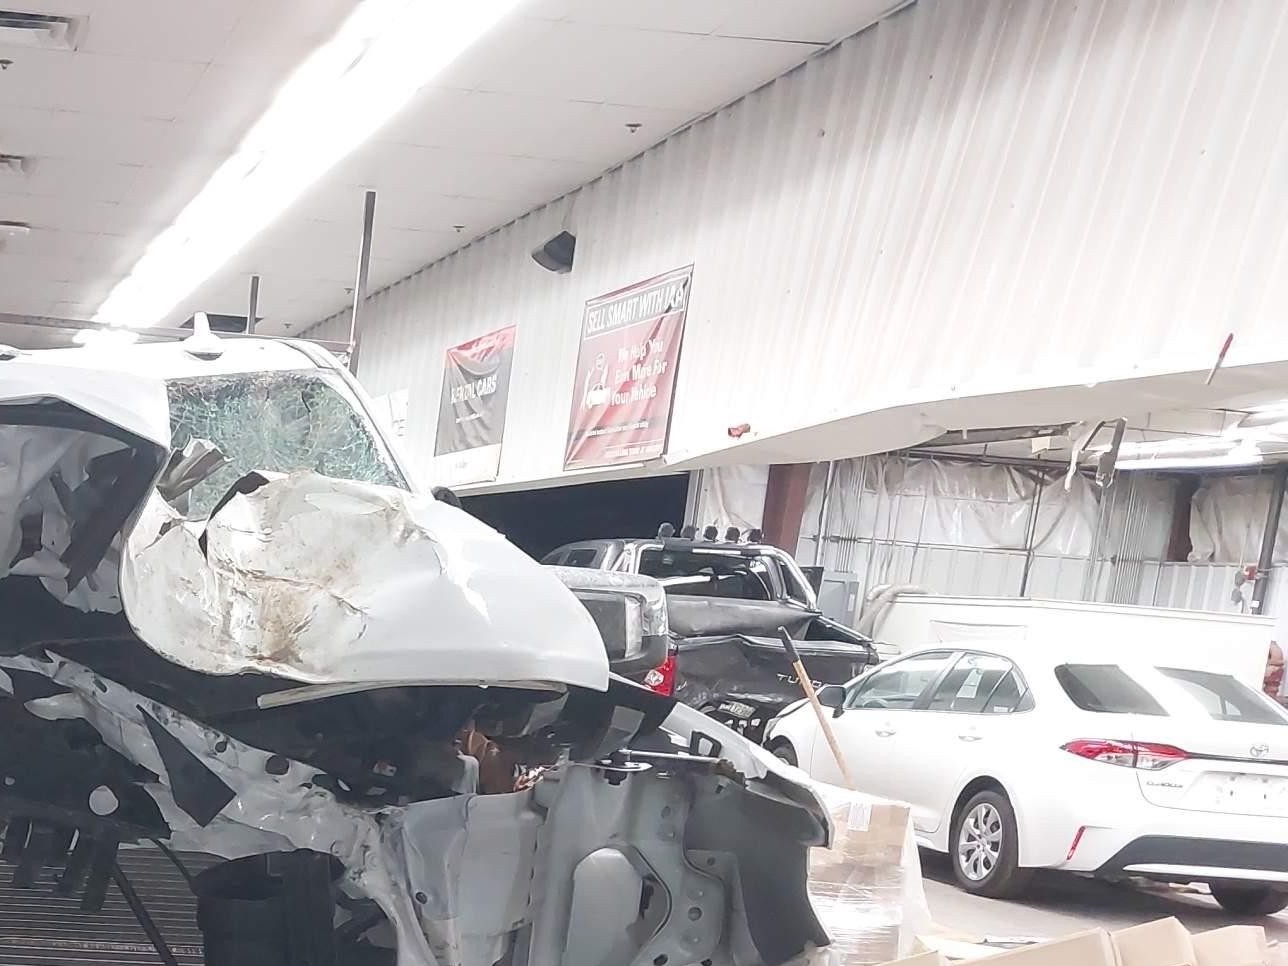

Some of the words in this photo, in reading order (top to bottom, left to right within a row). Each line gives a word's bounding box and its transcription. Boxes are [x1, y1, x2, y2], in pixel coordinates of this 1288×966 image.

[588, 308, 605, 333] SELL
[607, 298, 639, 327] SMART
[638, 288, 664, 318] WITH
[648, 339, 663, 354] You
[632, 363, 652, 381] More
[477, 374, 497, 397] CARS
